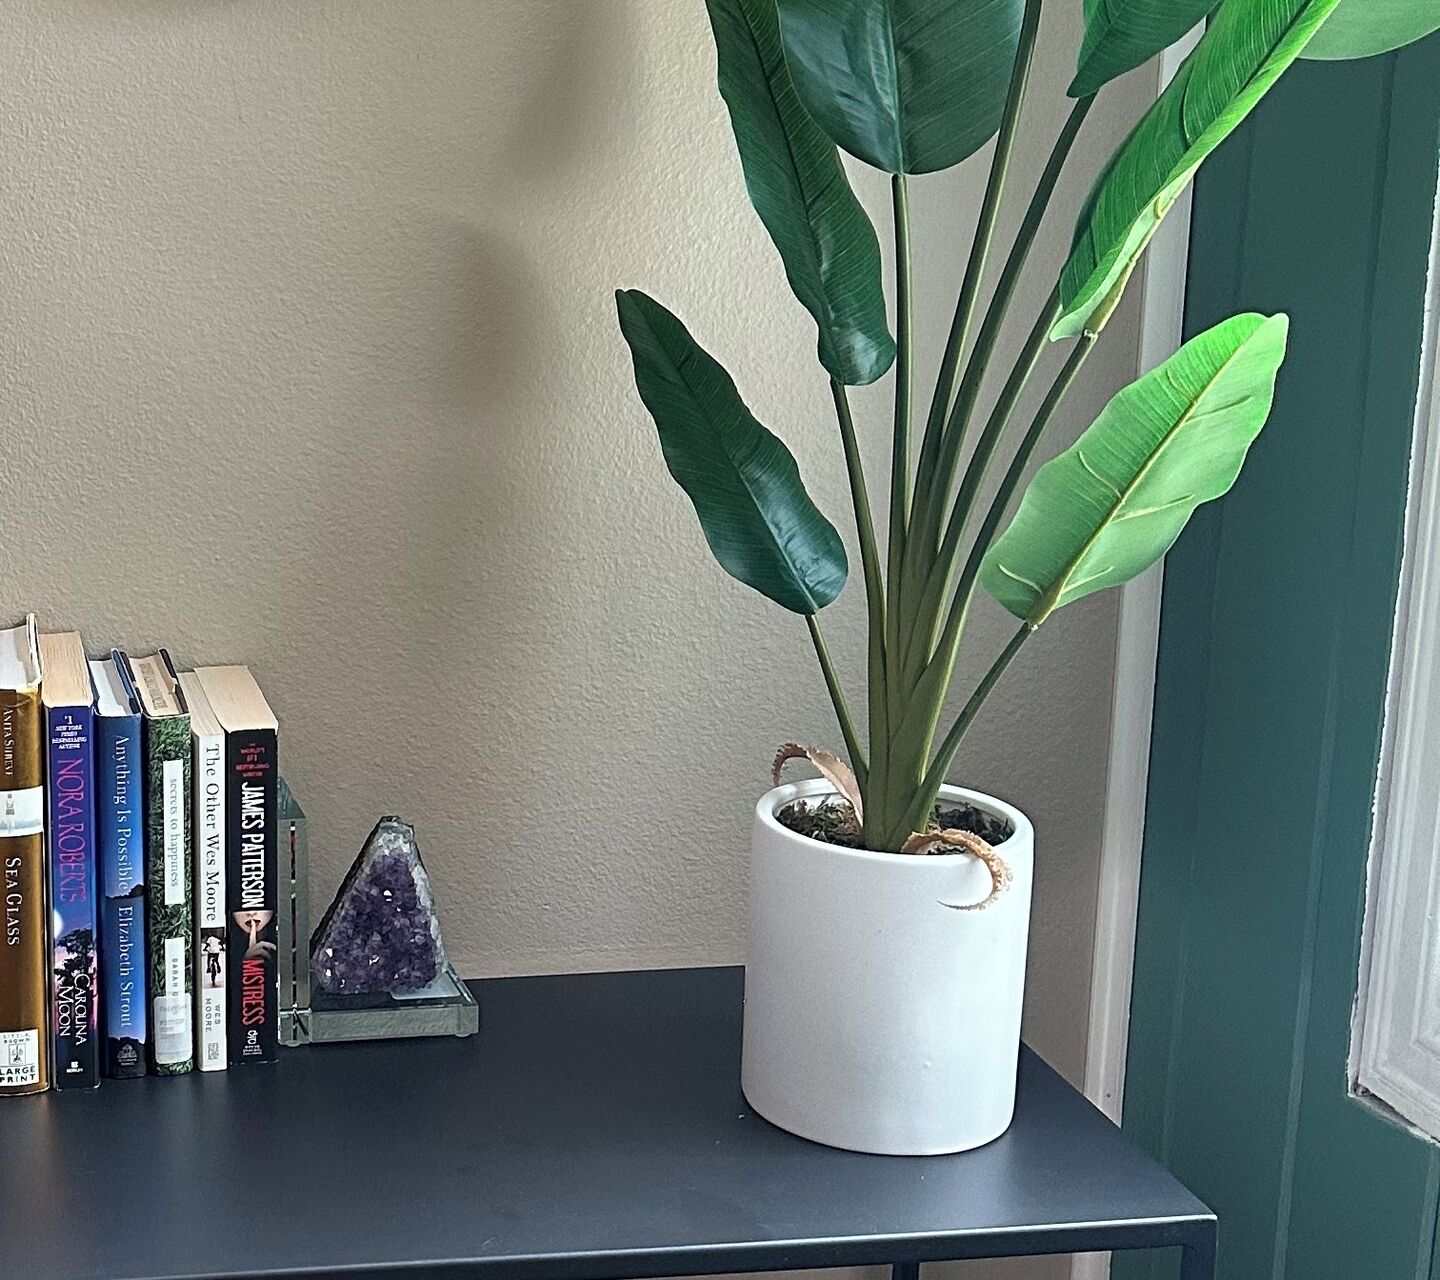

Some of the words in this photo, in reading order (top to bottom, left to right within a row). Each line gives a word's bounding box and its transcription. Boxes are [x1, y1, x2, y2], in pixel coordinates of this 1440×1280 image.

[3, 709, 14, 738] ANITA
[112, 734, 132, 805] Anything
[205, 743, 220, 777] The
[56, 758, 85, 820] NORA
[169, 778, 177, 816] secrets
[205, 782, 221, 830] Other
[241, 781, 265, 830] JAMES
[116, 809, 131, 823] Is
[169, 819, 178, 830] to
[5, 857, 22, 889] SEA
[58, 823, 87, 903] ROBERTS
[117, 828, 133, 894] Possible
[168, 833, 181, 888] happiness
[205, 833, 220, 866] Wes
[241, 833, 265, 908] PATTERSON
[6, 893, 23, 946] GLASS
[205, 871, 220, 922] Moore
[118, 906, 135, 977] Elizabeth
[58, 985, 74, 1037] MOON
[74, 973, 91, 1046] CAROLINA
[120, 981, 135, 1027] Strout
[242, 959, 265, 1026] MISTRESS
[0, 1065, 36, 1076] LARGE
[0, 1073, 36, 1083] PRINT
